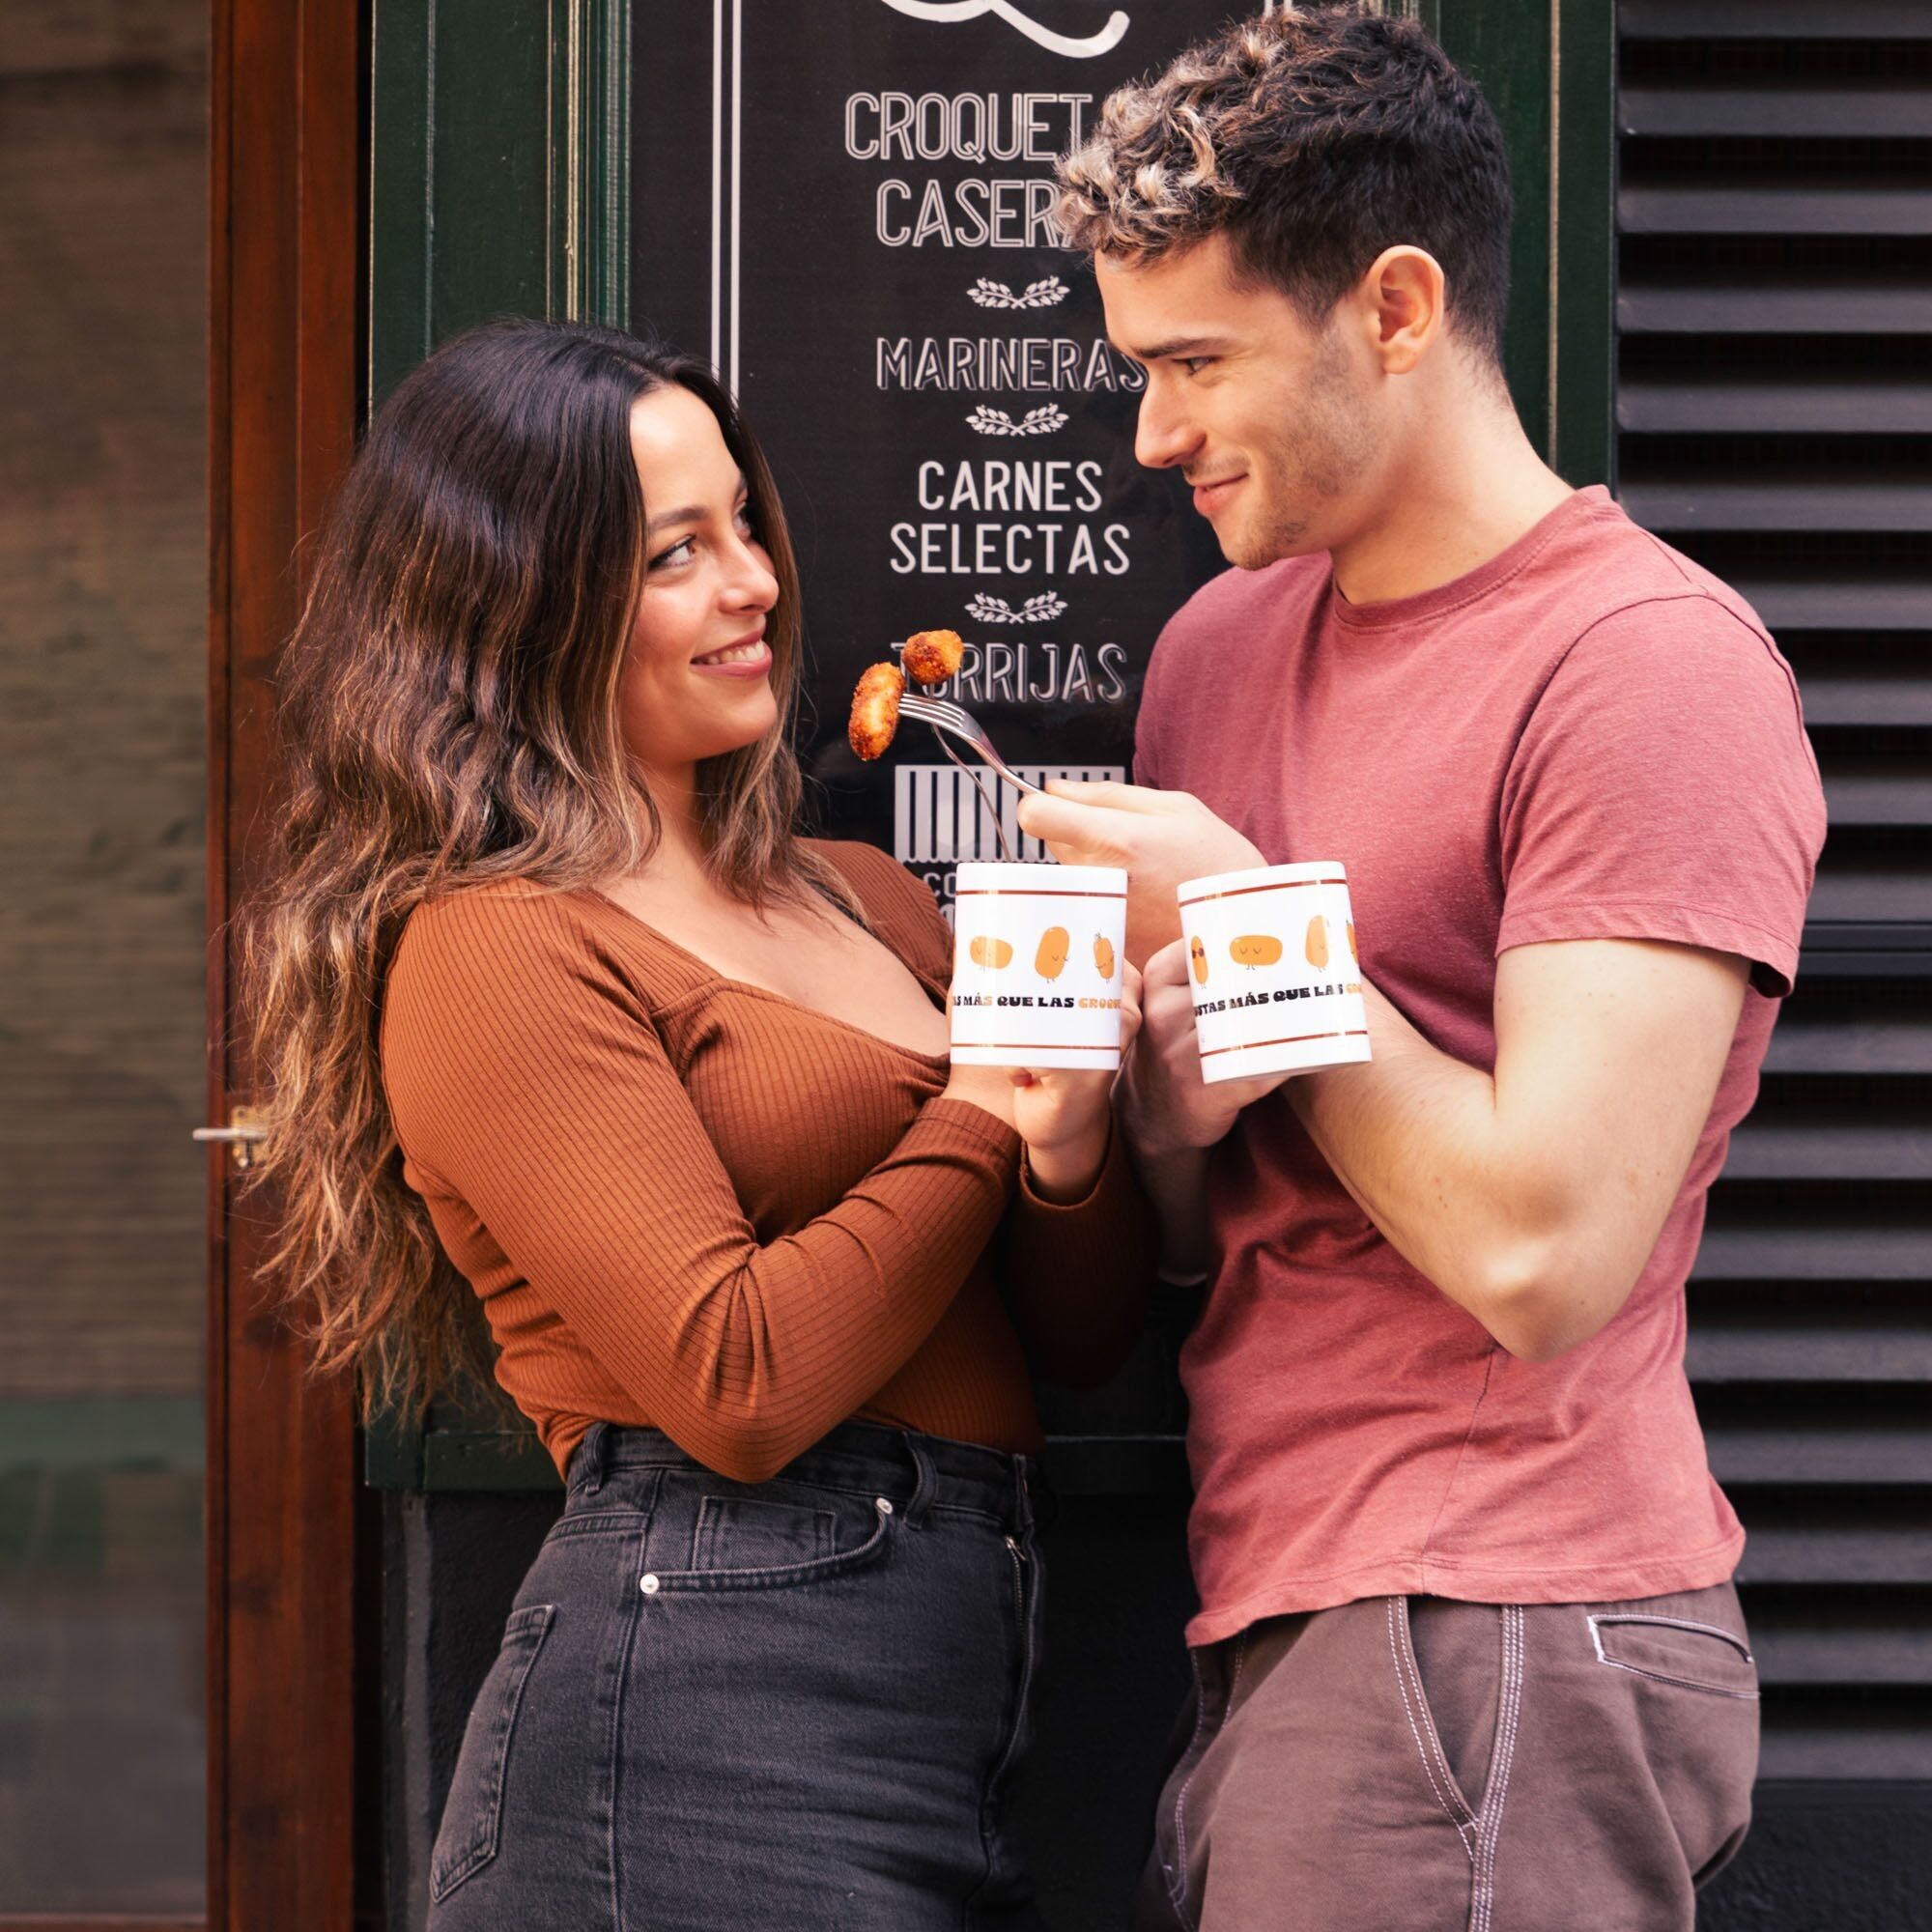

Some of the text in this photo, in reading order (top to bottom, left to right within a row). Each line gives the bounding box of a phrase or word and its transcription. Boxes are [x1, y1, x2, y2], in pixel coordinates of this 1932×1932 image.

[876, 179, 1072, 247] CASER
[876, 337, 1148, 392] MARINERAS
[918, 461, 1102, 512] CARNES
[890, 523, 1130, 575] SELECTAS
[997, 996, 1034, 1007] QUE
[1037, 997, 1074, 1009] LAS
[1230, 992, 1269, 1009] MÁS
[1273, 987, 1311, 1002] QUE
